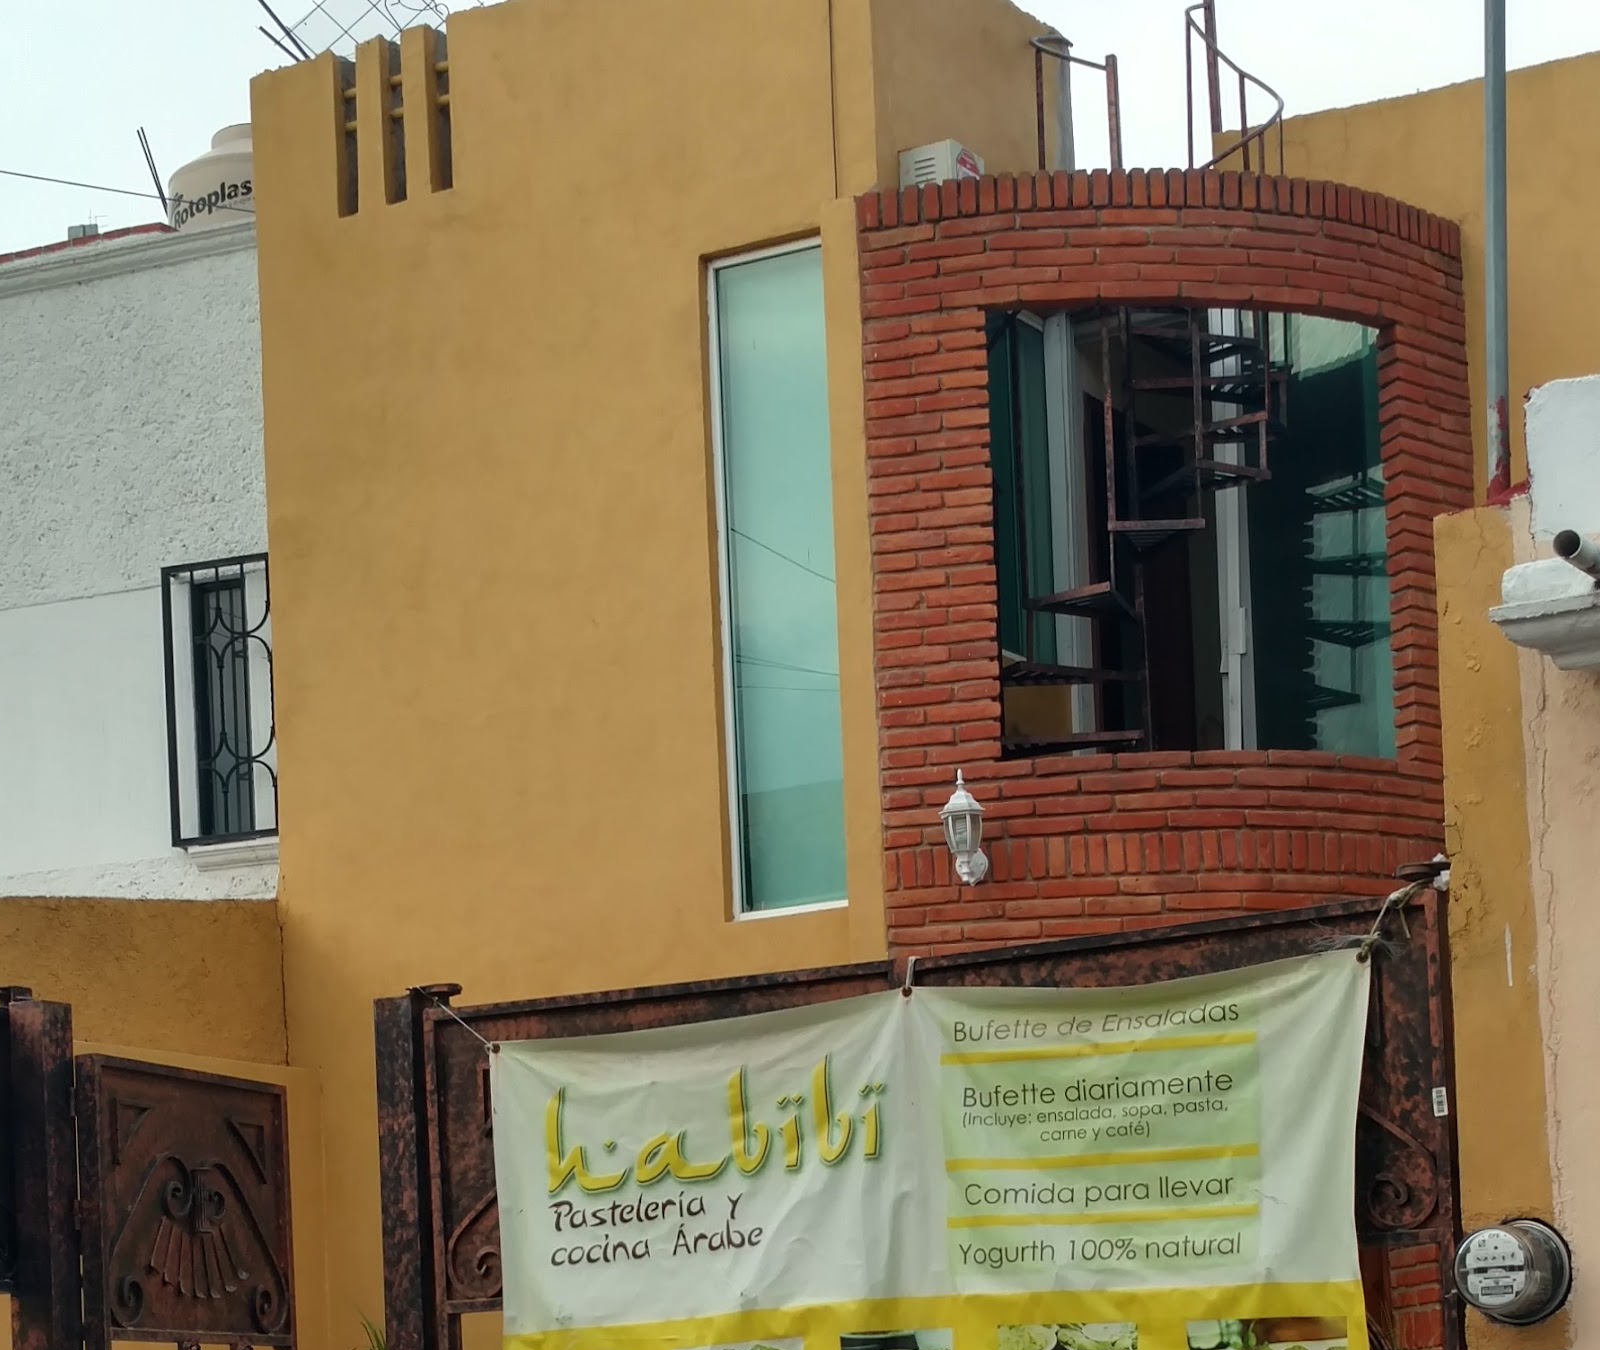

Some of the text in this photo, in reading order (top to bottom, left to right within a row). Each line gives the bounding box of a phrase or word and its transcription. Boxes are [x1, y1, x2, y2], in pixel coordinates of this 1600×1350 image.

[174, 180, 253, 230] Rotoplas
[953, 1002, 1240, 1042] Bufette de Ensaladas
[963, 1069, 1234, 1108] Bufette diariamente
[962, 1097, 1229, 1128] (Incluye: ensalada, sopa, pasta,
[1040, 1120, 1151, 1142] carne y café)
[964, 1175, 1235, 1207] Comida para llevar
[549, 1190, 706, 1232] Pastelería
[551, 1219, 764, 1267] cocina Árabe
[958, 1232, 1242, 1269] Yogurth 100% natural
